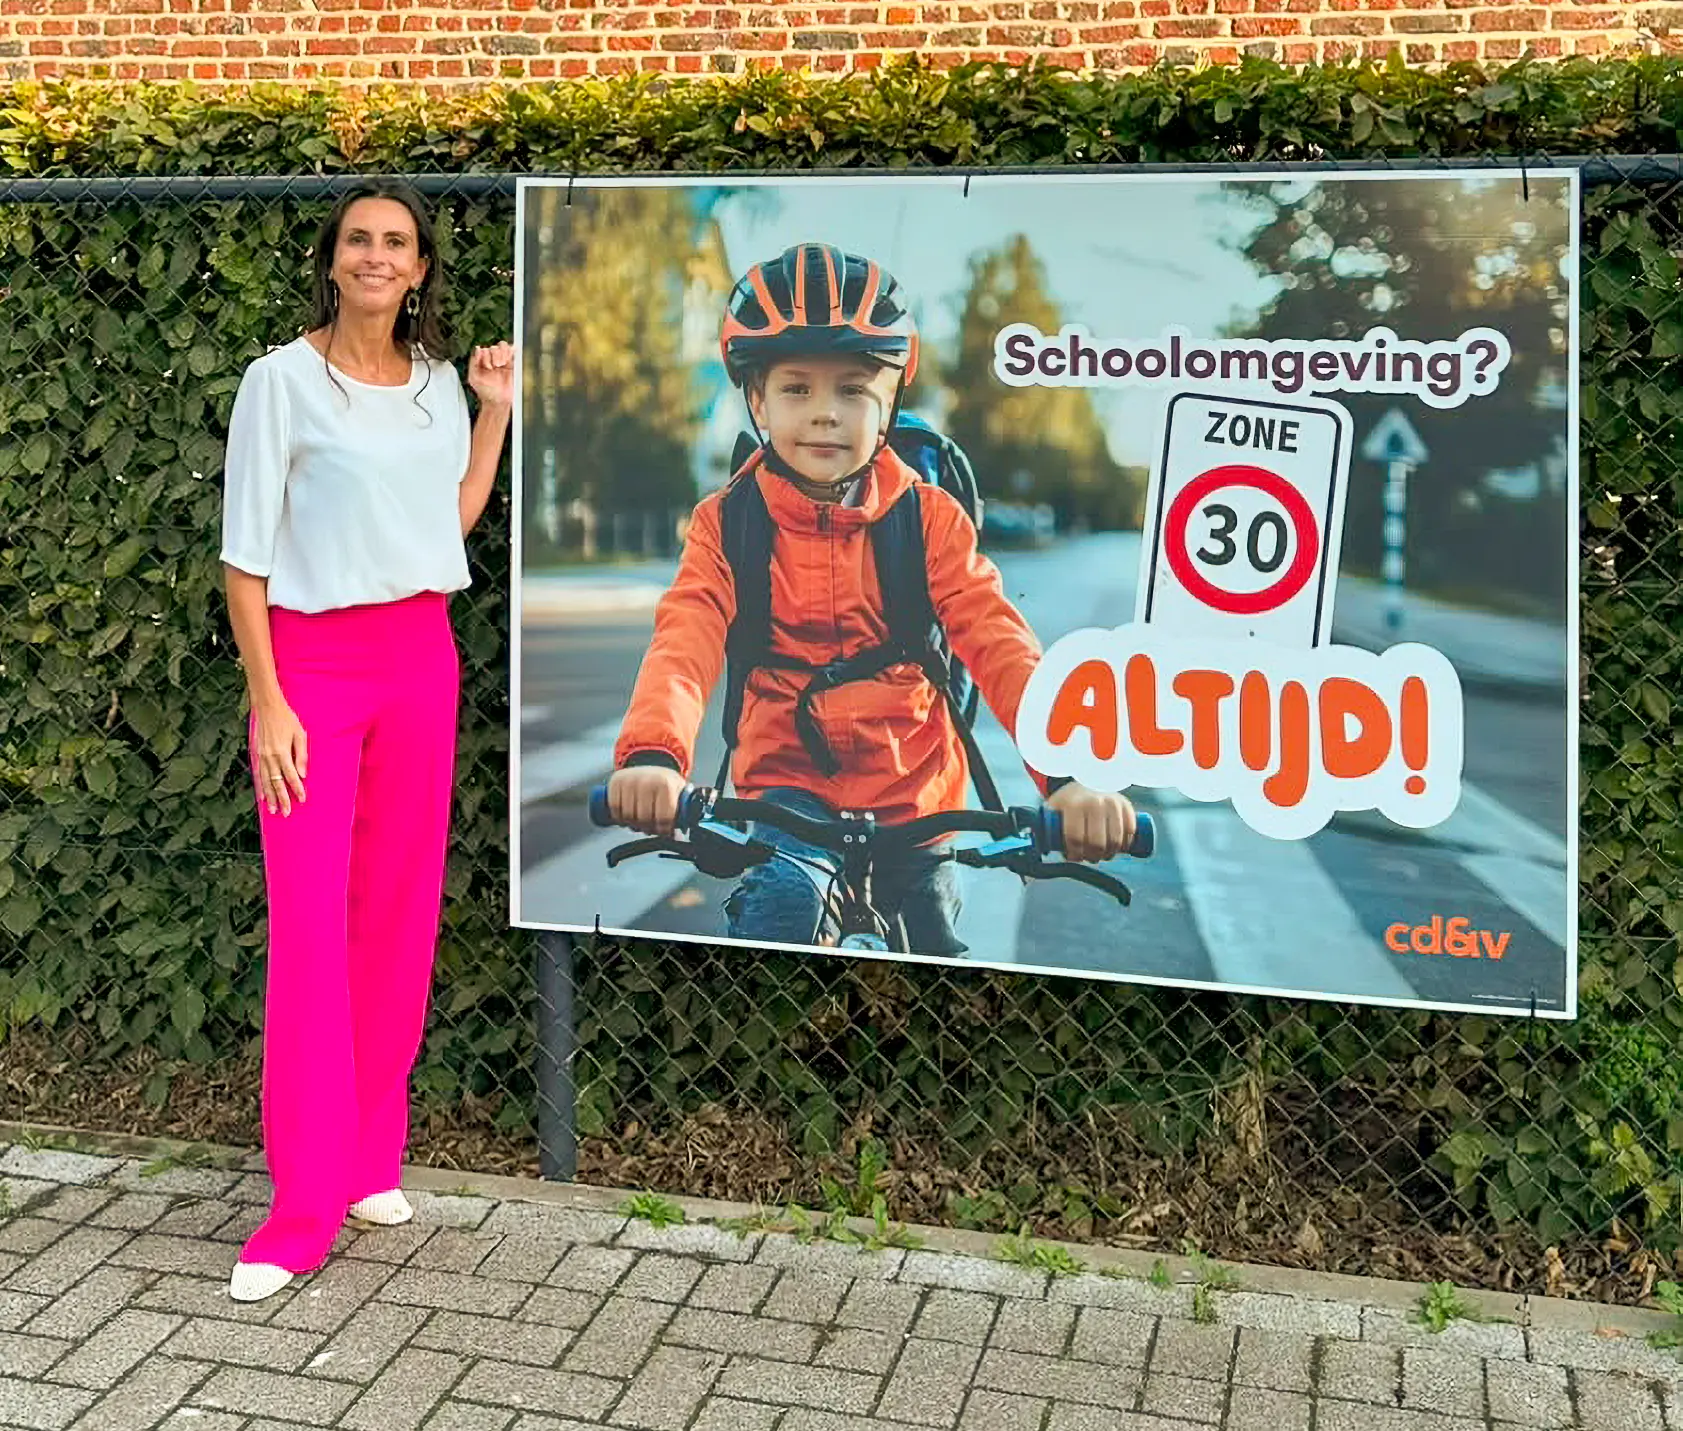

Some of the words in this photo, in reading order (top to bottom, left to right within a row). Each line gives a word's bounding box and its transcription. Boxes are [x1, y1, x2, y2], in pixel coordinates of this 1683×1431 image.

[1004, 334, 1498, 396] Schoolomgeving?
[1204, 411, 1300, 453] ZONE
[1195, 504, 1289, 573] 30
[1046, 653, 1429, 807] ALTIJD!
[1385, 914, 1511, 960] cd&v
